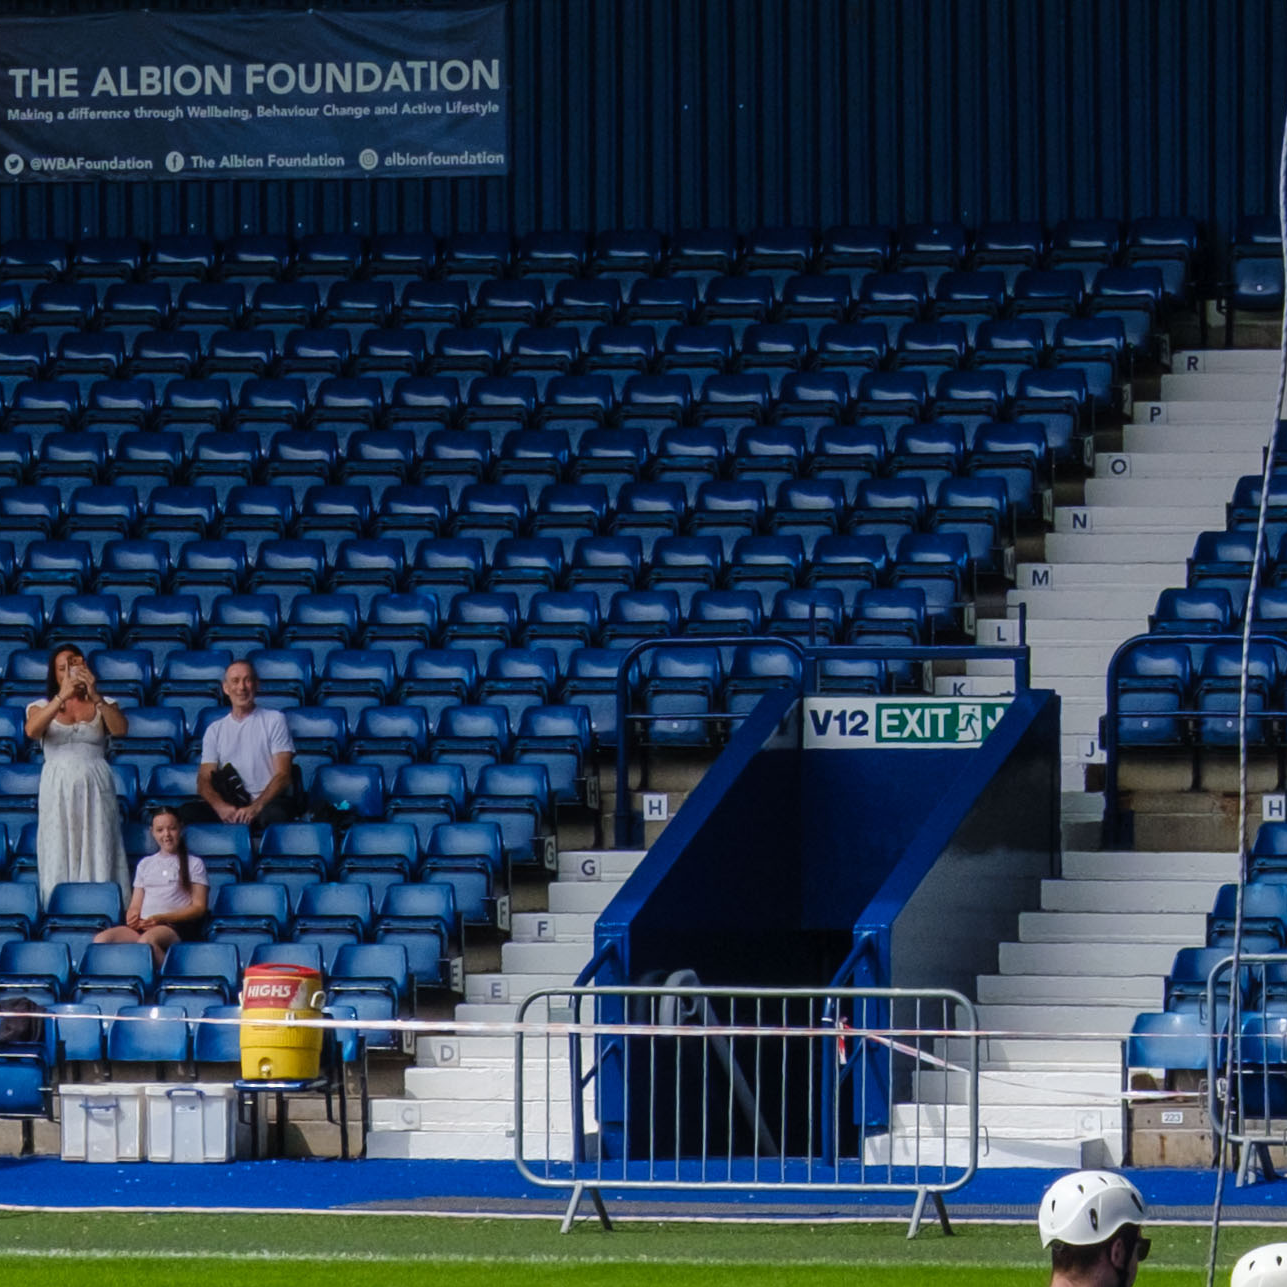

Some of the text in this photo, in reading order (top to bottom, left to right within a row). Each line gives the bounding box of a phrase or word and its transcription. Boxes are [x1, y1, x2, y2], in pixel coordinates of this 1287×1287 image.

[8, 59, 500, 98] THE ALBION FOUNDATION
[7, 101, 499, 123] Making a difference through Wellbeing, Behaviour Change and Active Lifestyle
[30, 157, 153, 171] @WBAFoundation
[191, 153, 345, 169] The Albion Foundation
[384, 152, 505, 167] albionfoundation
[1187, 356, 1199, 371] R
[1150, 406, 1162, 421] P
[1111, 459, 1126, 475] O
[1073, 513, 1087, 529] N
[1032, 570, 1049, 585] M
[997, 626, 1007, 642] L
[954, 682, 965, 696] K
[810, 708, 952, 738] V12 EXIT
[1085, 741, 1095, 758] J
[649, 799, 662, 815] H
[1269, 800, 1282, 816] H
[545, 841, 554, 865] G
[582, 859, 596, 876] G
[499, 900, 508, 925] F
[538, 921, 548, 937] F
[452, 964, 460, 987] E
[491, 982, 501, 998] E
[441, 1045, 454, 1062] D
[401, 1107, 414, 1125] C
[1081, 1112, 1095, 1131] C
[1164, 1113, 1181, 1122] 223
